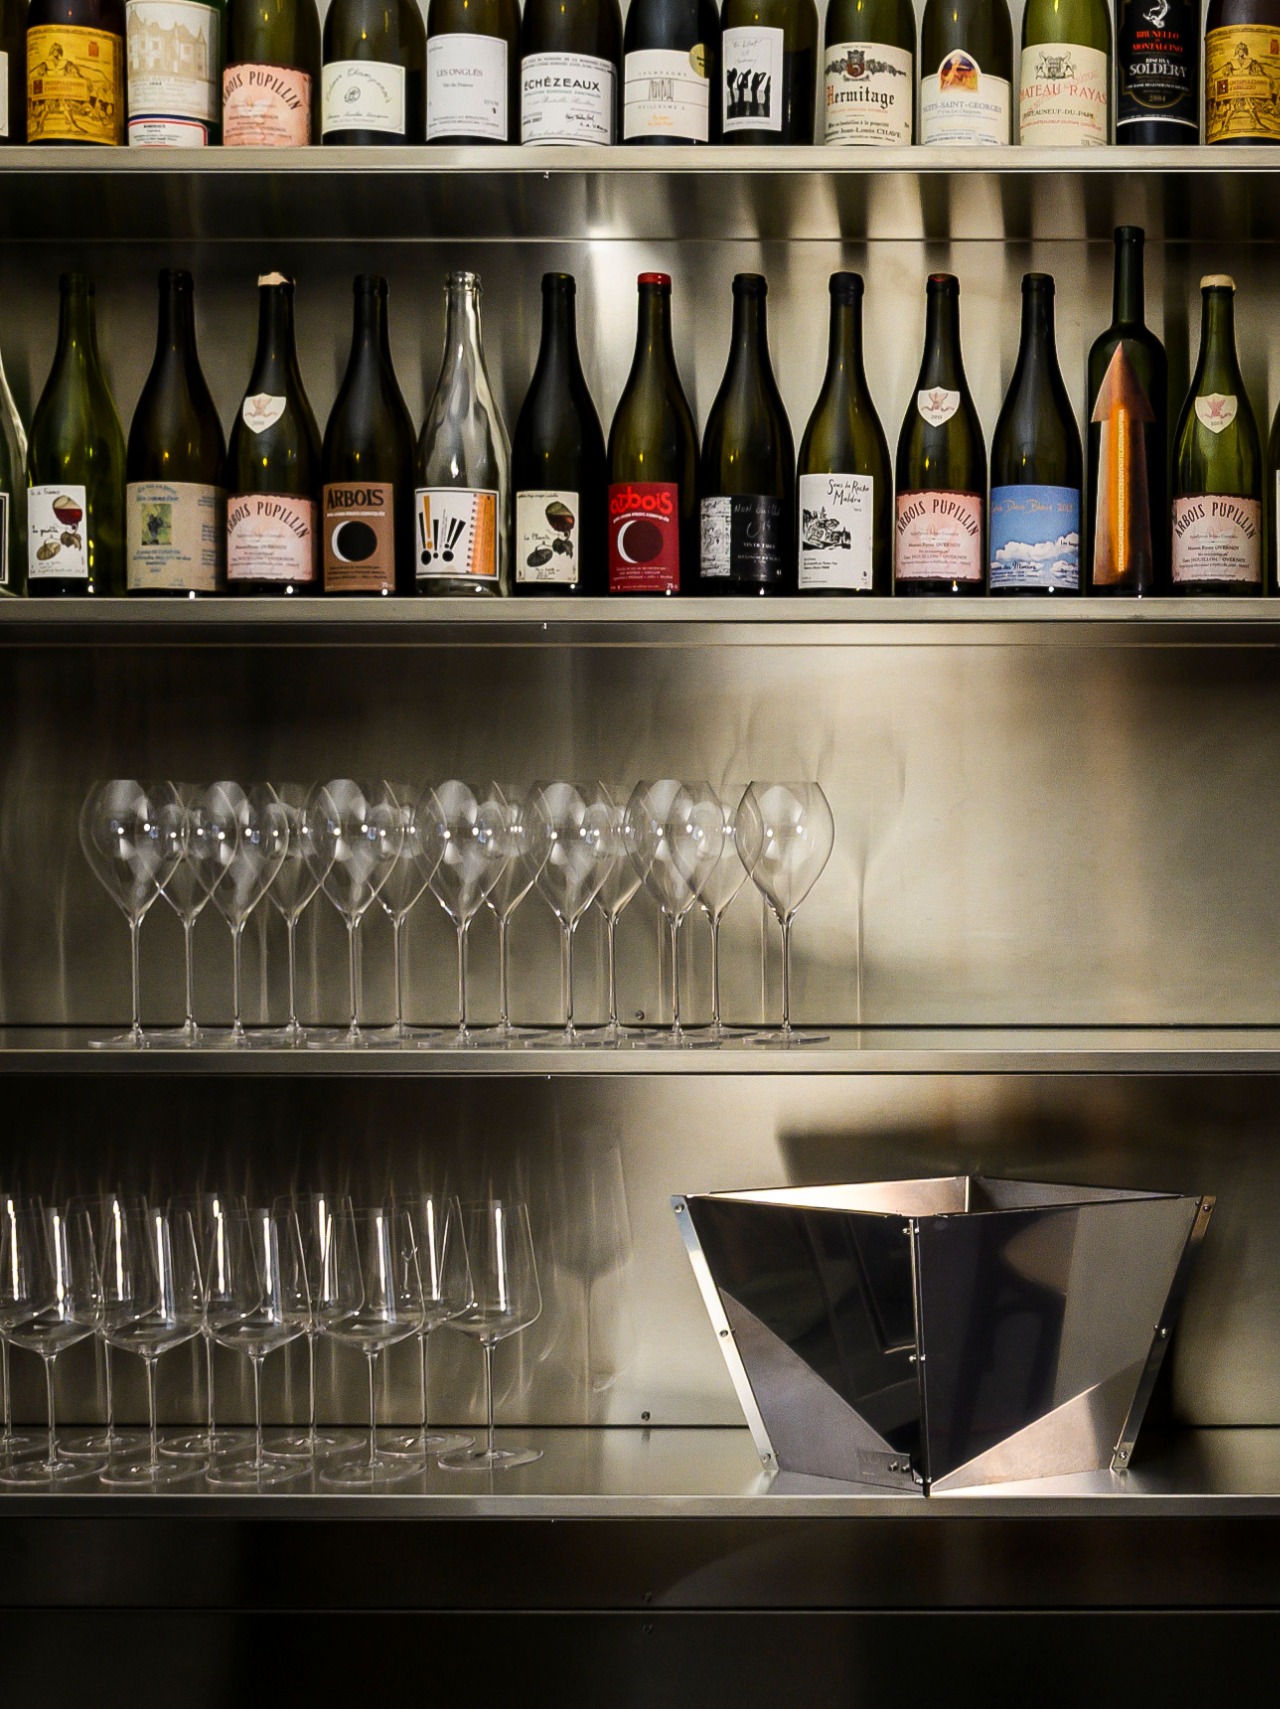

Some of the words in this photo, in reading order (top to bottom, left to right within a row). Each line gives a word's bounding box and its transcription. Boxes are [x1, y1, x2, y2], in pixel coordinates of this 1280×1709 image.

[1129, 62, 1187, 78] SOLDERA
[249, 70, 302, 110] PUPILLIN
[826, 84, 895, 110] Hermitage
[327, 488, 385, 509] ARBOIS
[257, 501, 311, 539] PUPILLIN
[896, 500, 926, 536] ARBOIS
[932, 499, 979, 537] PUPILLIN
[1174, 503, 1206, 540] ARBOIS
[1211, 501, 1257, 540] PUPILLIN
